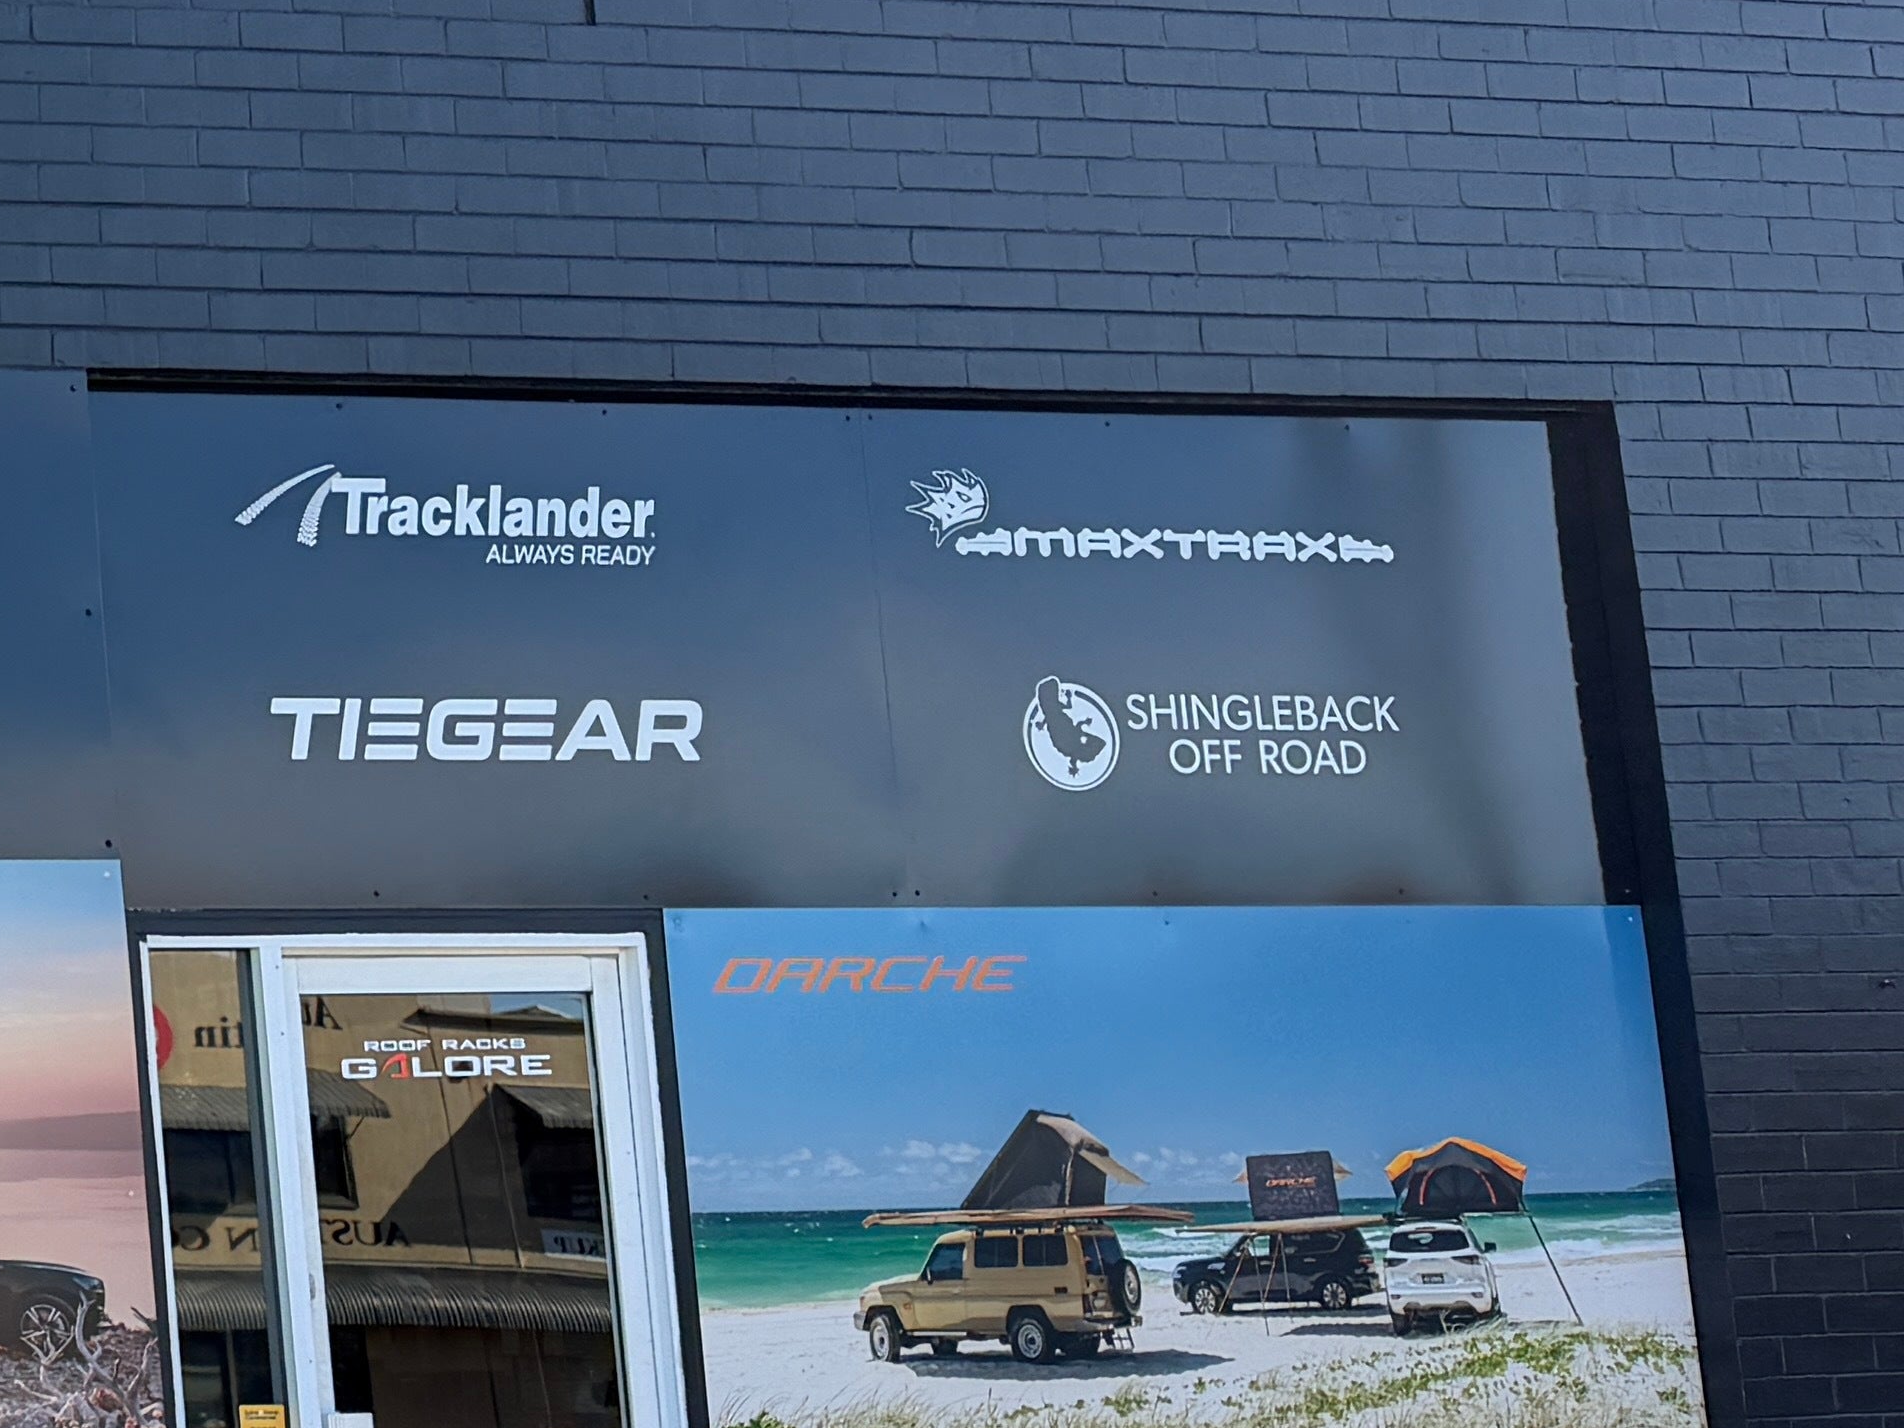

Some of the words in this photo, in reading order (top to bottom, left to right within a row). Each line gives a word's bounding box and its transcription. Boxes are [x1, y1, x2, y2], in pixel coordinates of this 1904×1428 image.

[485, 543, 575, 565] ALWAYS
[580, 544, 656, 566] READY
[1014, 526, 1339, 563] MAXTRAX
[270, 697, 703, 762] TIEGEAR
[1126, 693, 1400, 732] SHINGLEBACK
[1169, 738, 1242, 774] OFF
[1258, 739, 1367, 775] ROAD
[713, 955, 1028, 994] DARCHE
[363, 1039, 432, 1052] ROOF
[441, 1037, 526, 1051] RACKS
[340, 1052, 553, 1080] GALORE
